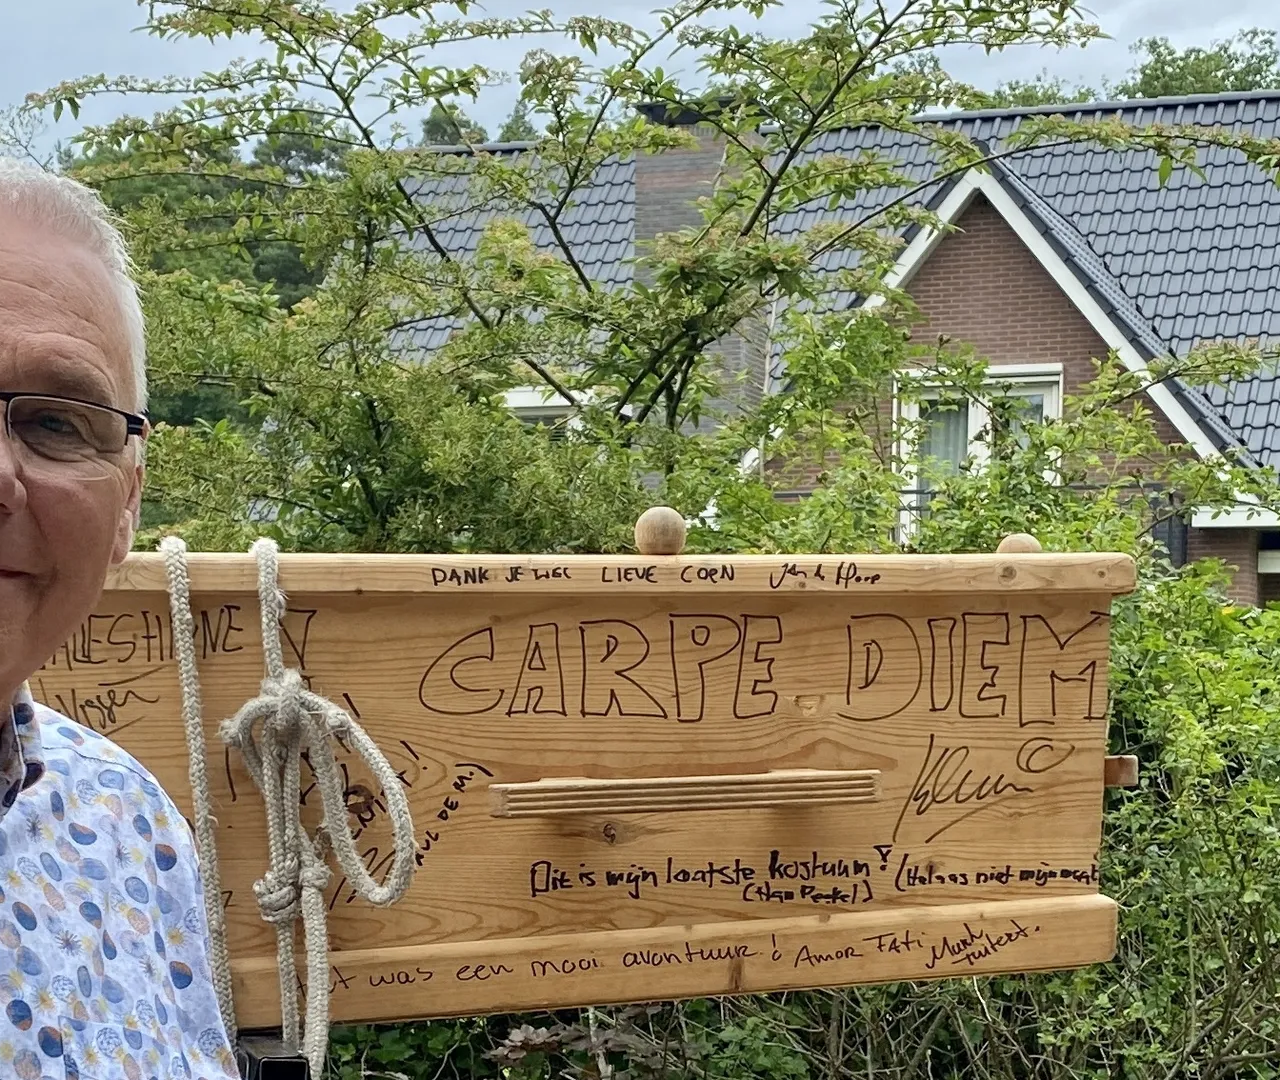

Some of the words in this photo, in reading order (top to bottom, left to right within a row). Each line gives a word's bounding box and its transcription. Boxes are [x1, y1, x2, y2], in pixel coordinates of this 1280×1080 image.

[431, 566, 490, 587] DANK
[600, 566, 660, 585] LIEVE
[418, 613, 784, 723] CARPE
[835, 611, 1112, 729] DIEM
[578, 863, 597, 887] is
[369, 966, 435, 988] was
[456, 963, 515, 981] een
[530, 957, 599, 978] mooi
